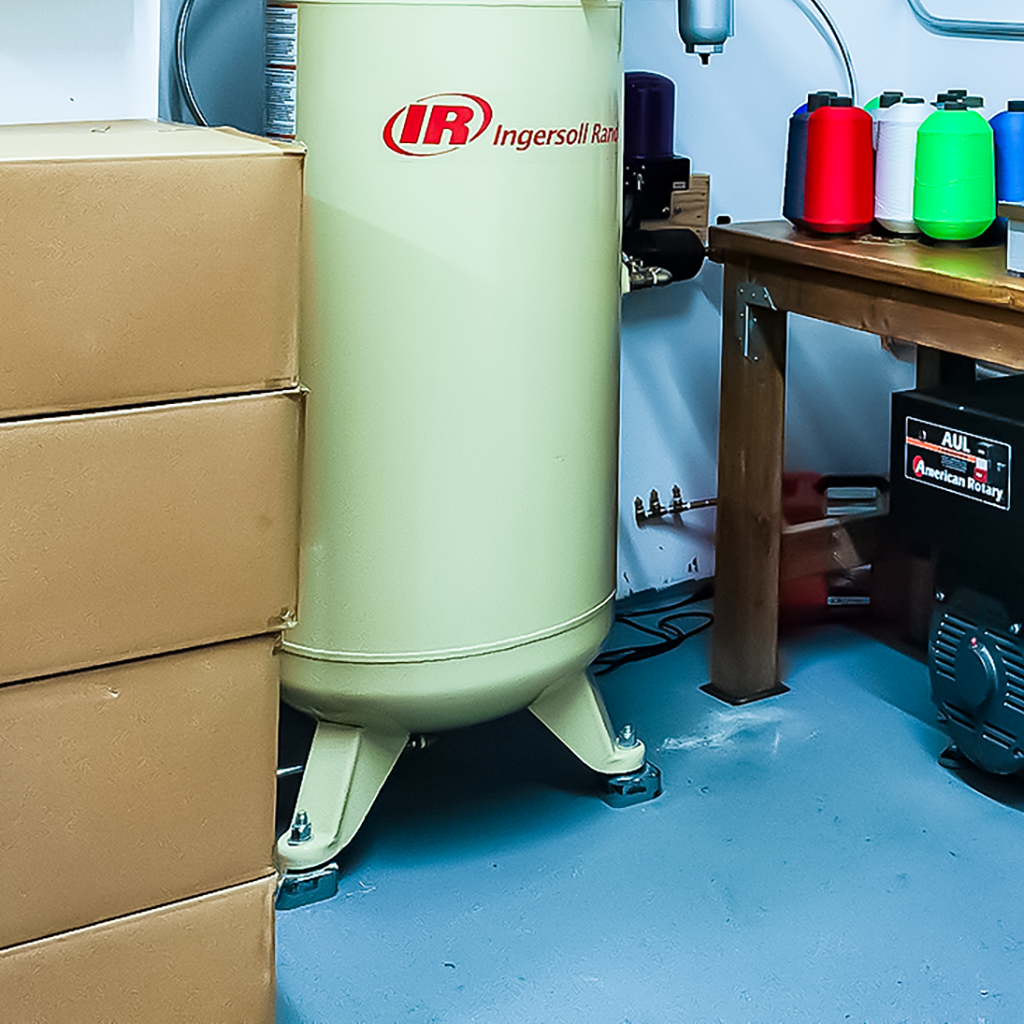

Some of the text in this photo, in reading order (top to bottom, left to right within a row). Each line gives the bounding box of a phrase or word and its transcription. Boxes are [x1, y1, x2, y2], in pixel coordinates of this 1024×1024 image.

[399, 104, 475, 145] IR
[493, 123, 588, 151] Ingersoll
[941, 431, 971, 453] AUL
[914, 458, 966, 488] American
[967, 476, 1004, 503] Rotary
